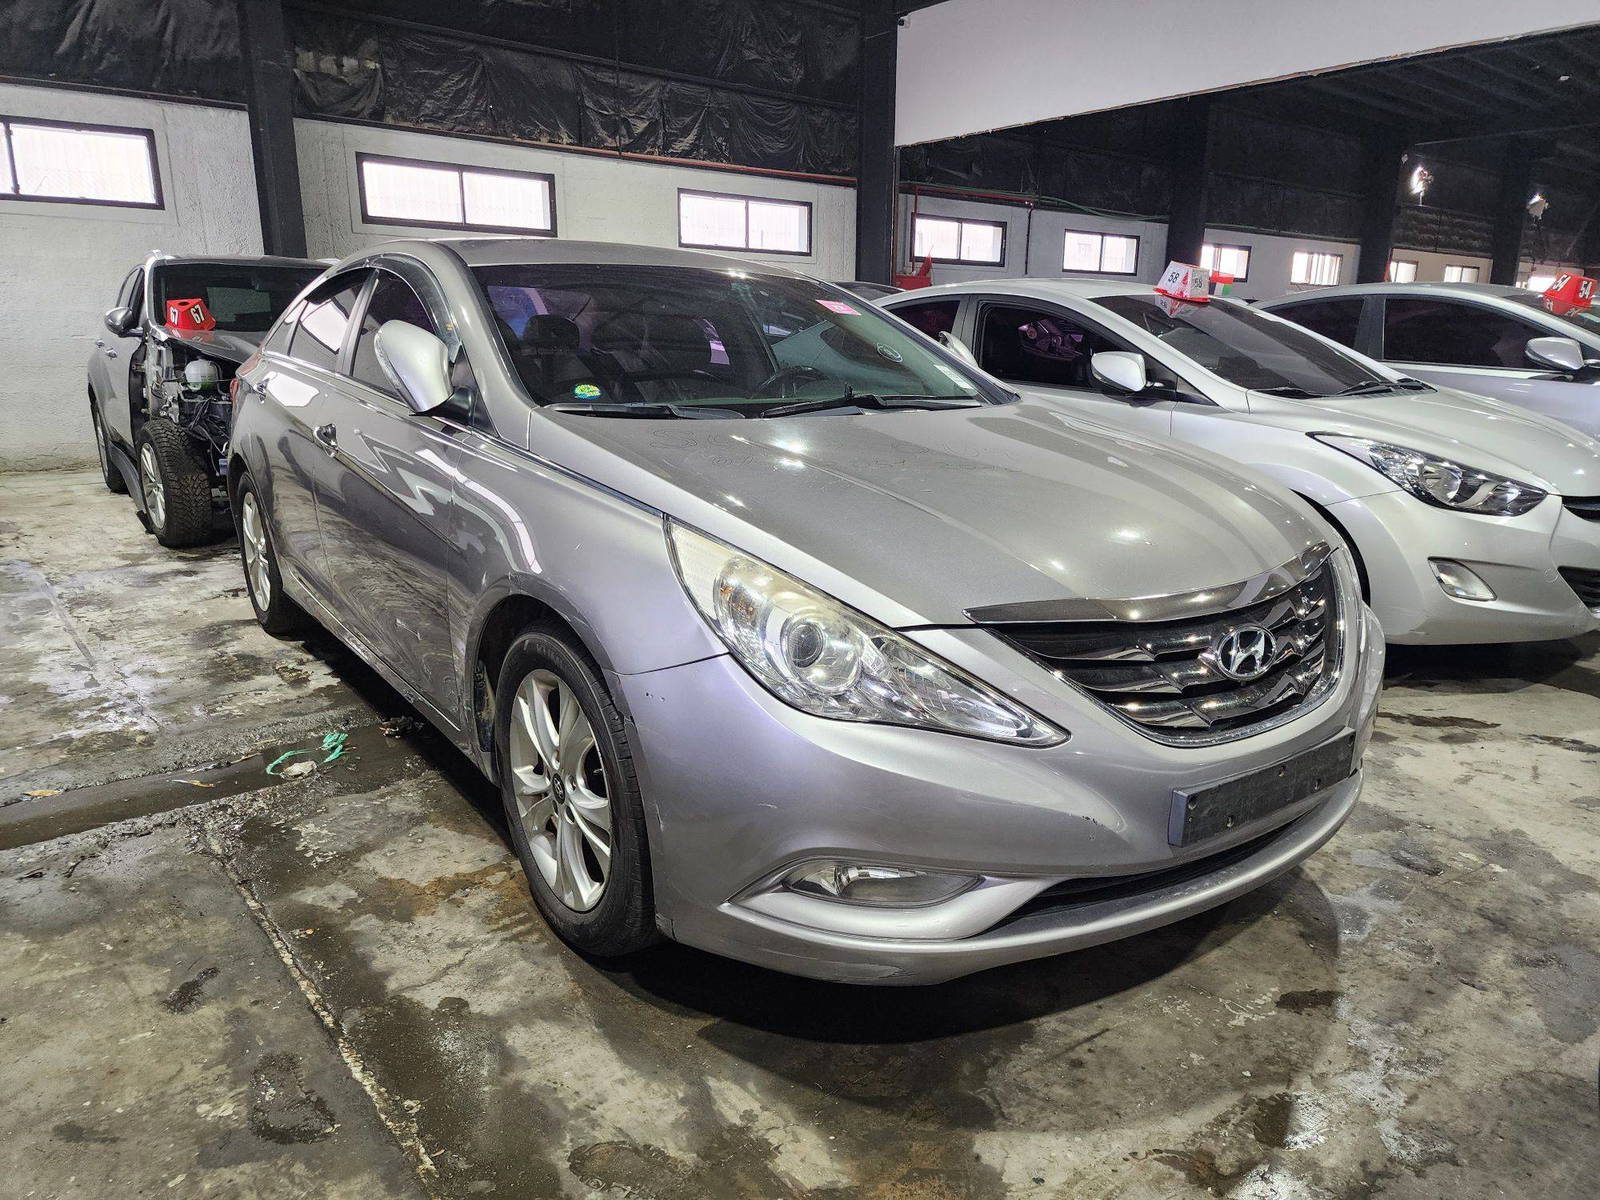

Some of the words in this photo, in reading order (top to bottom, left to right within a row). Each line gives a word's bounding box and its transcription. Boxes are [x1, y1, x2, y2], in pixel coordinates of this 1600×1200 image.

[1168, 272, 1179, 283] 58
[1579, 280, 1592, 299] 54
[190, 304, 205, 324] 67
